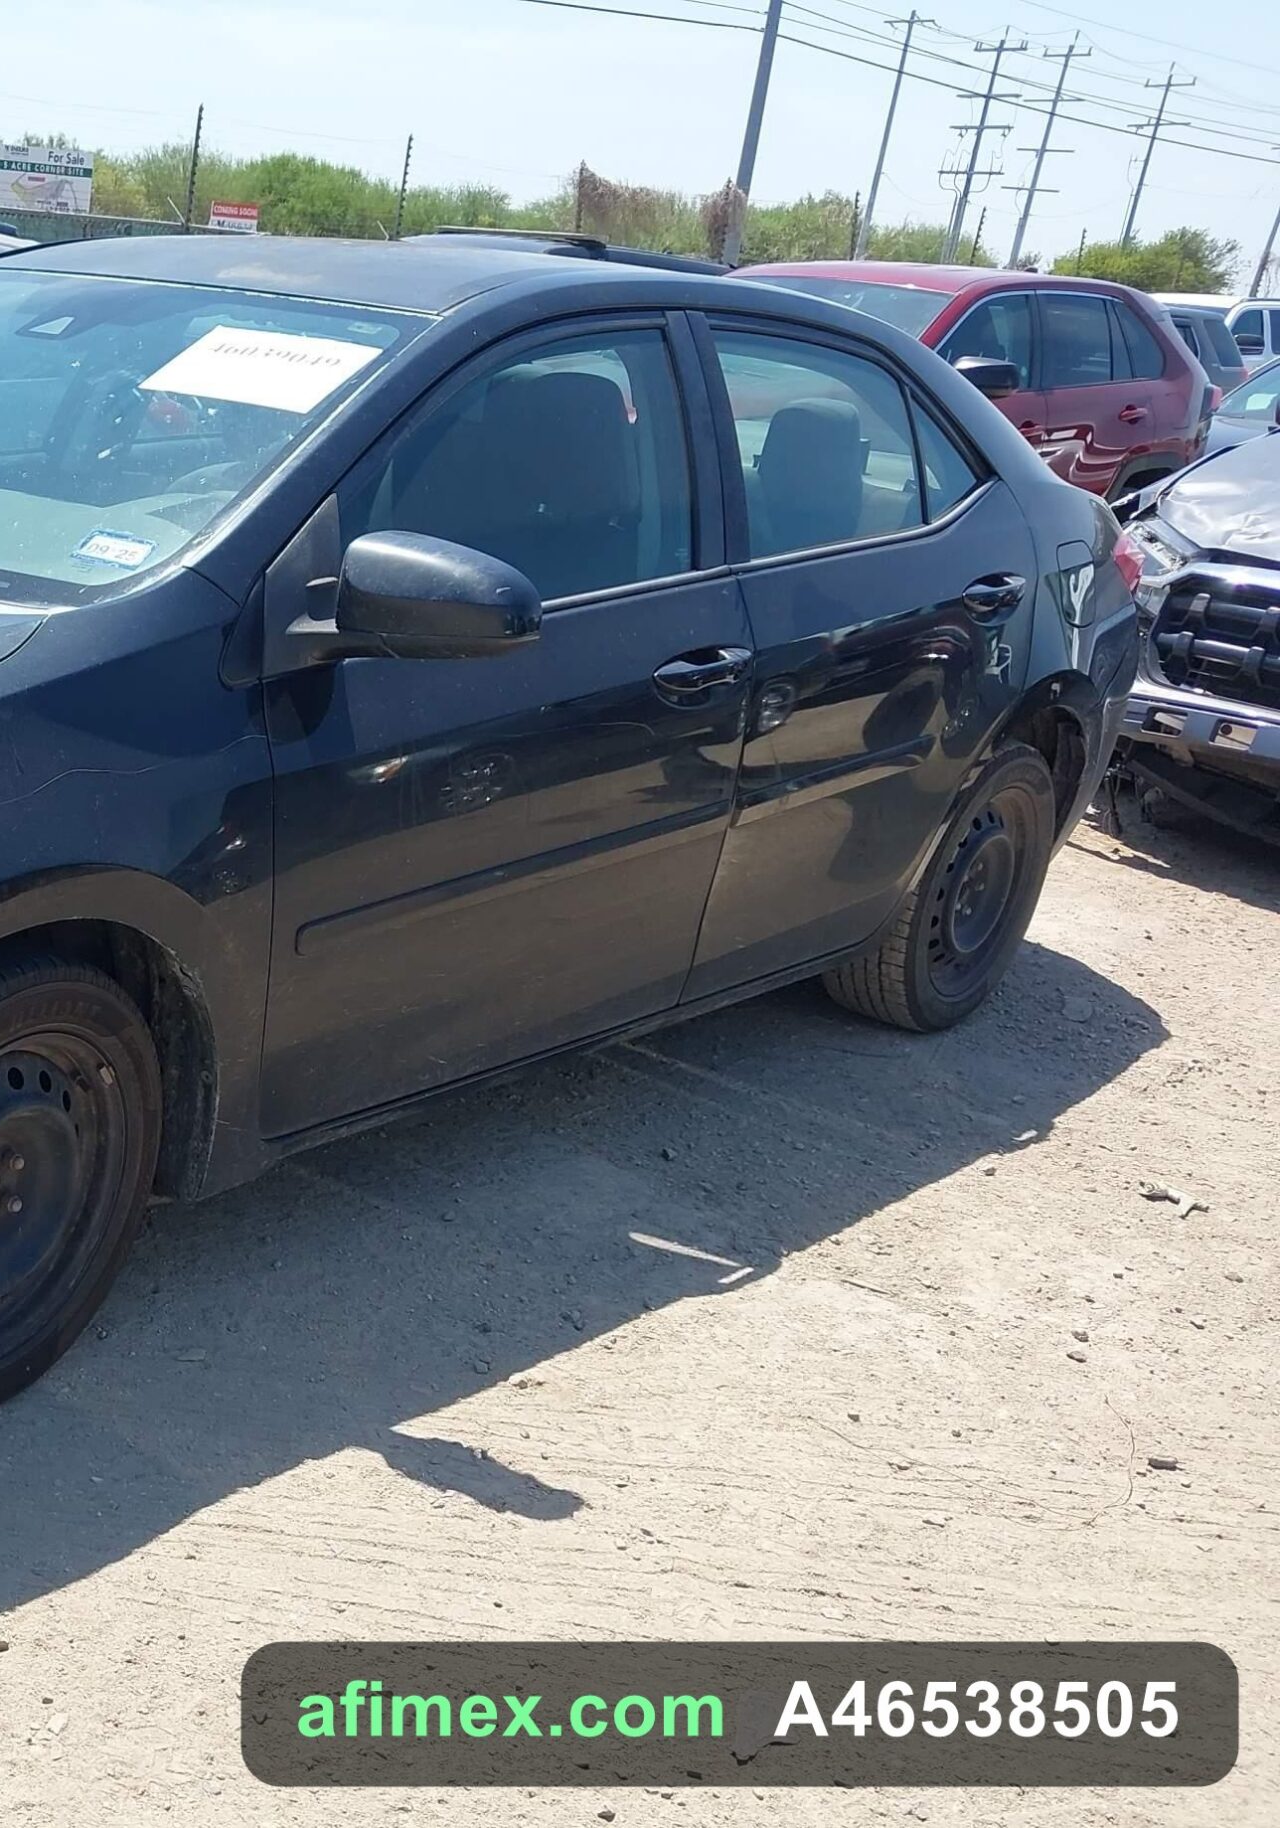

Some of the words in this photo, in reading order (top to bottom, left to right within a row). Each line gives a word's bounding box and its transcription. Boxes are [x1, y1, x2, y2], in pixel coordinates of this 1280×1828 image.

[48, 151, 64, 164] For
[66, 152, 85, 166] Sale
[35, 165, 65, 174] CORNER
[68, 167, 84, 176] SITE
[214, 204, 239, 215] COMING
